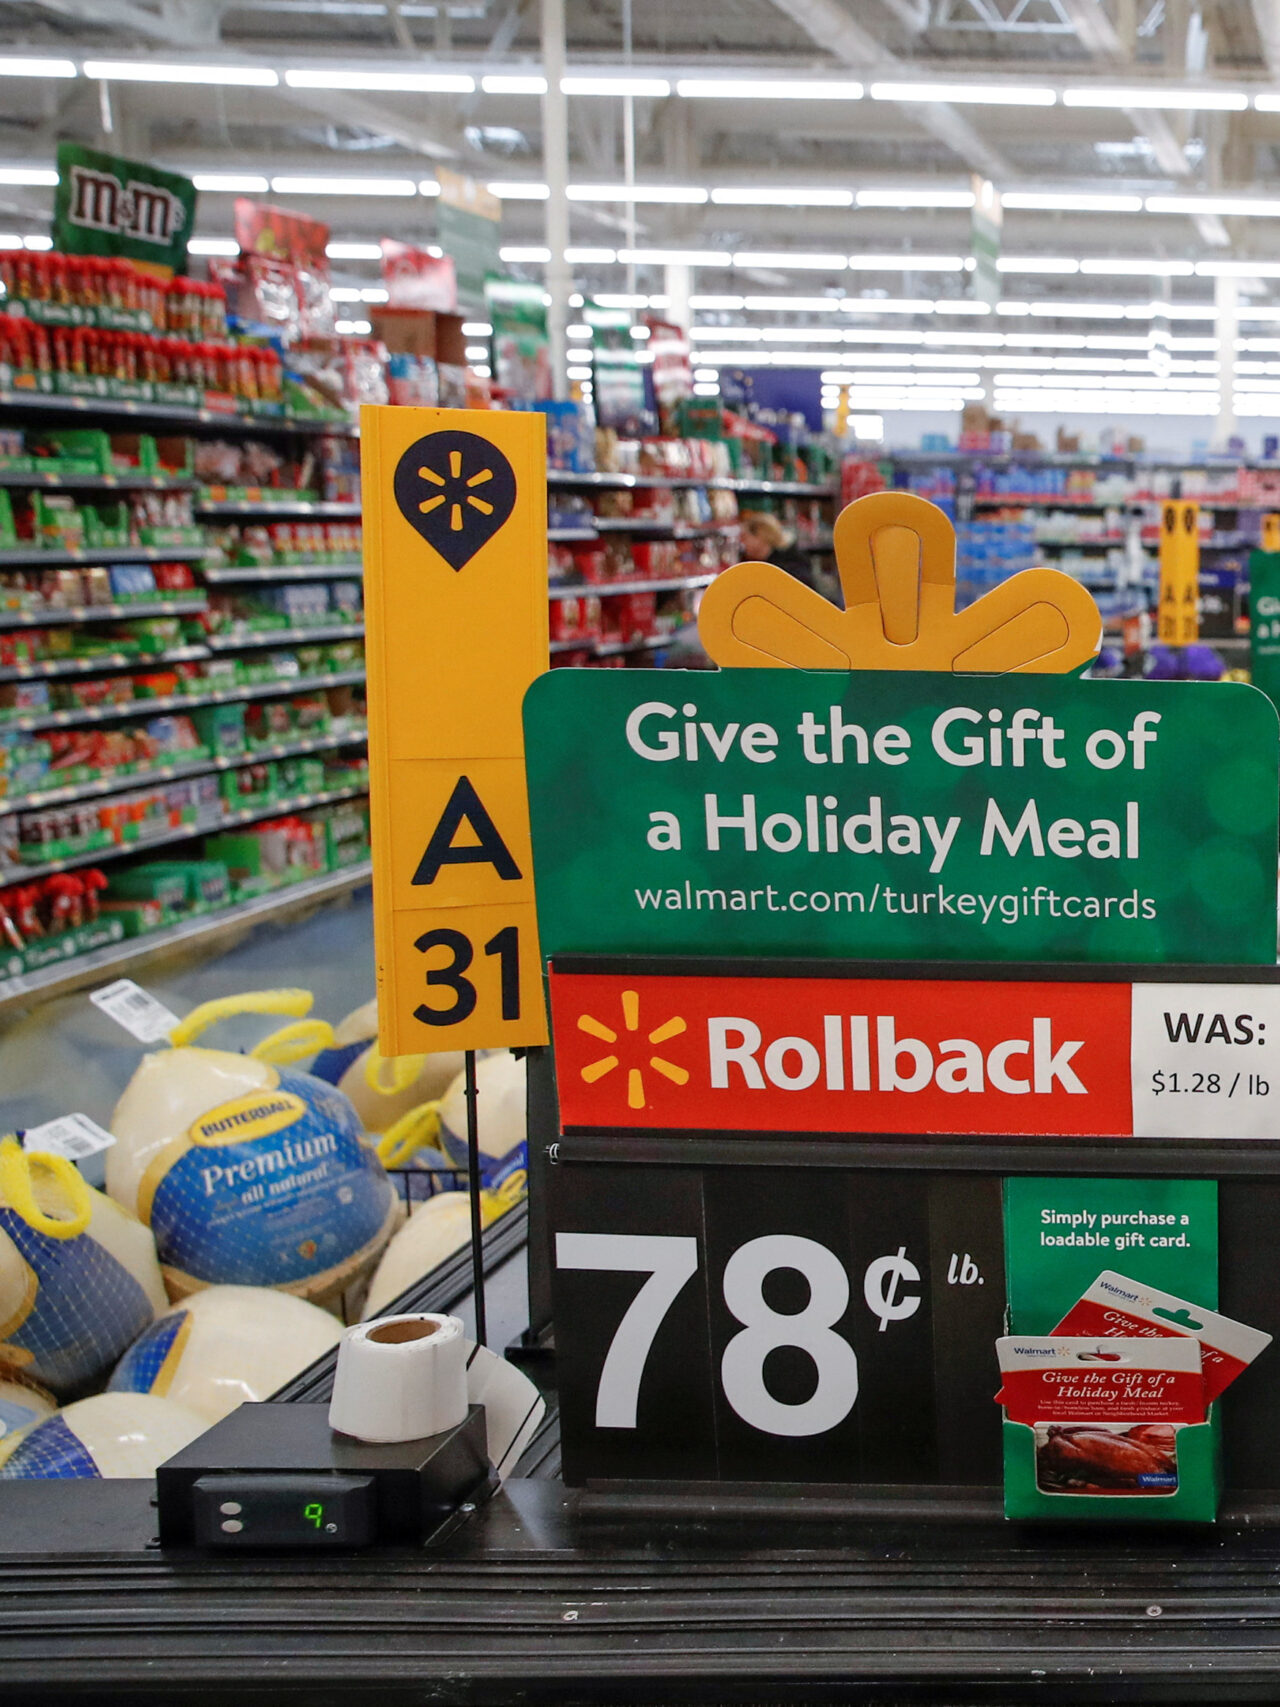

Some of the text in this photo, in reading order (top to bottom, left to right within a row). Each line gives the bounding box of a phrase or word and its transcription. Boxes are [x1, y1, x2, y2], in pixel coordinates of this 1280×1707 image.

[626, 702, 1161, 769] Give the Gift of
[411, 775, 523, 886] A
[647, 794, 1139, 873] a Holiday Meal
[635, 881, 1157, 924] walmart.com/turkeygiftcards
[413, 927, 520, 1026] 31
[1164, 1012, 1266, 1046] WAS:
[708, 1014, 1089, 1095] Rollback
[1152, 1069, 1221, 1096] $1.28
[1249, 1074, 1270, 1096] lb
[200, 1100, 295, 1138] BUTTERBALL
[201, 1133, 339, 1197] Premium
[241, 1161, 328, 1205] all natural
[1041, 1209, 1189, 1229] Simply purchase a
[1041, 1232, 1191, 1251] loadable gift card.
[947, 1253, 985, 1286] lb.
[1100, 1281, 1139, 1301] Walmart
[1103, 1311, 1138, 1330] Give
[1014, 1347, 1056, 1355] Walmart
[1042, 1371, 1176, 1387] Give the Gift of a
[1057, 1387, 1164, 1402] Holiday Meal
[1142, 1475, 1177, 1483] Walmart
[304, 1503, 323, 1528] 9
